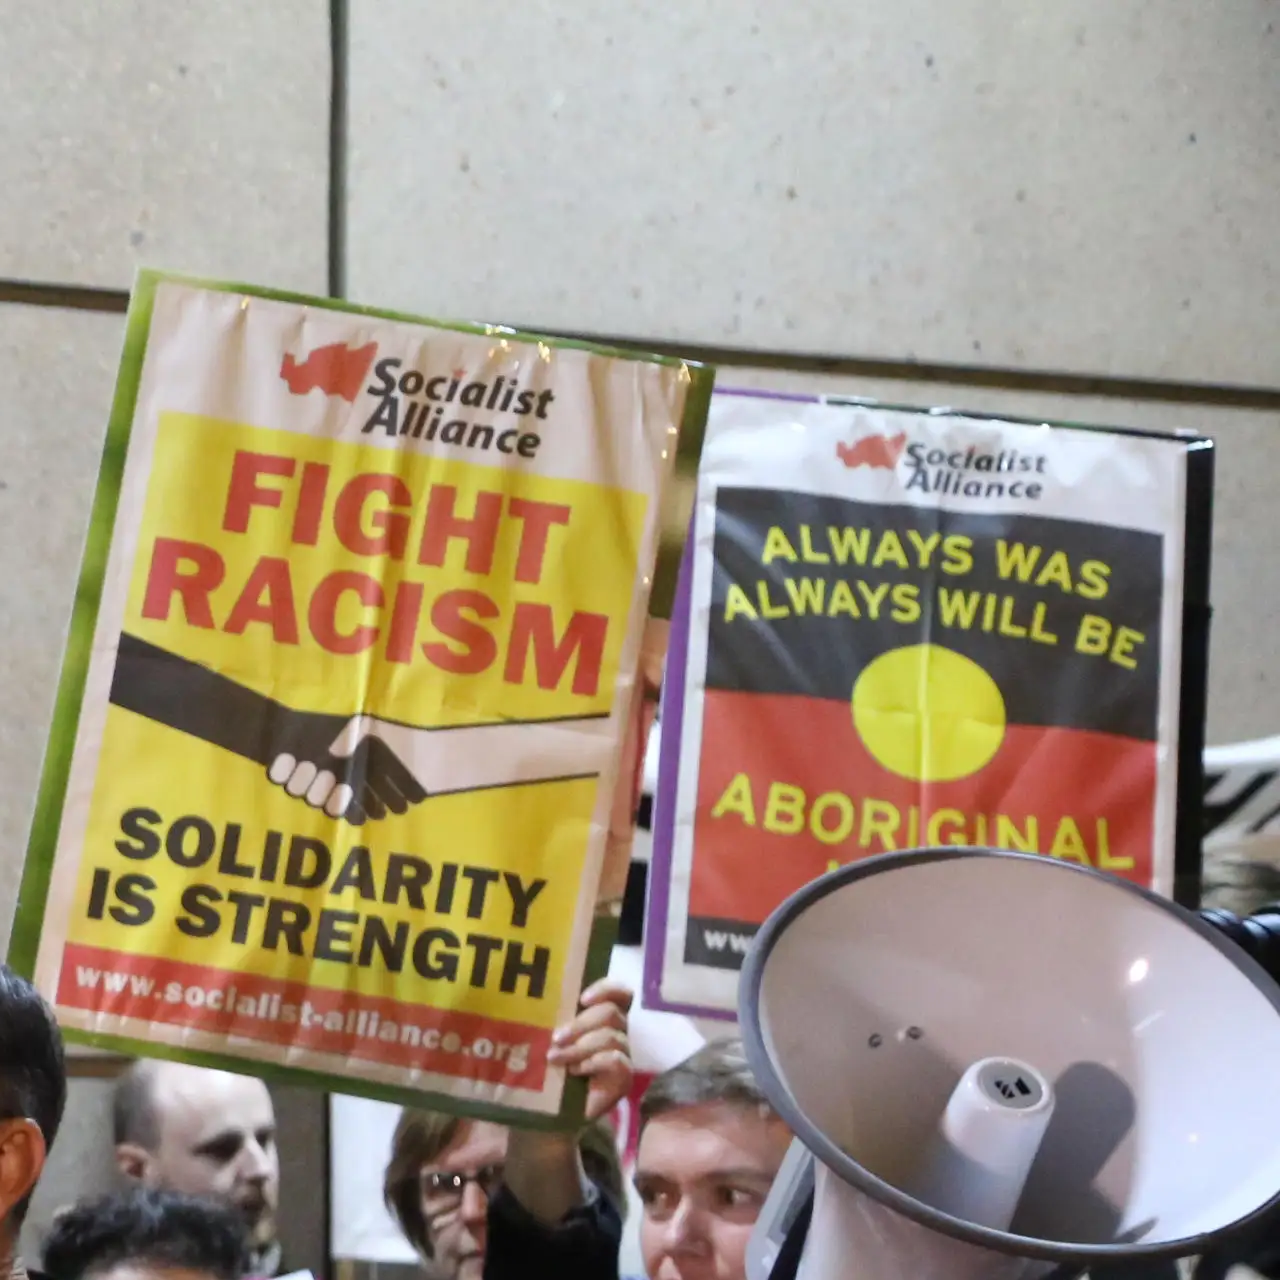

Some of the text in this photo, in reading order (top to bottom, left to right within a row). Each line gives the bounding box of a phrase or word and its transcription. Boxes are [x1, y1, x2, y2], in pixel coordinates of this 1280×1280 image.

[360, 393, 542, 460] Alliance
[367, 356, 556, 422] Socialist
[904, 442, 1047, 476] Socialist
[906, 465, 1044, 501] Alliance
[221, 449, 571, 585] FIGHT
[761, 524, 1112, 599] ALWAYS WAS
[140, 535, 609, 697] RACISM
[723, 578, 1146, 670] ALWAYS WILL BE
[114, 806, 547, 929] SOLIDARITY
[711, 773, 1136, 870] ABORIGINAL
[85, 868, 551, 1000] IS STRENGTH
[75, 965, 532, 1072] www.socialist-alliance.org
